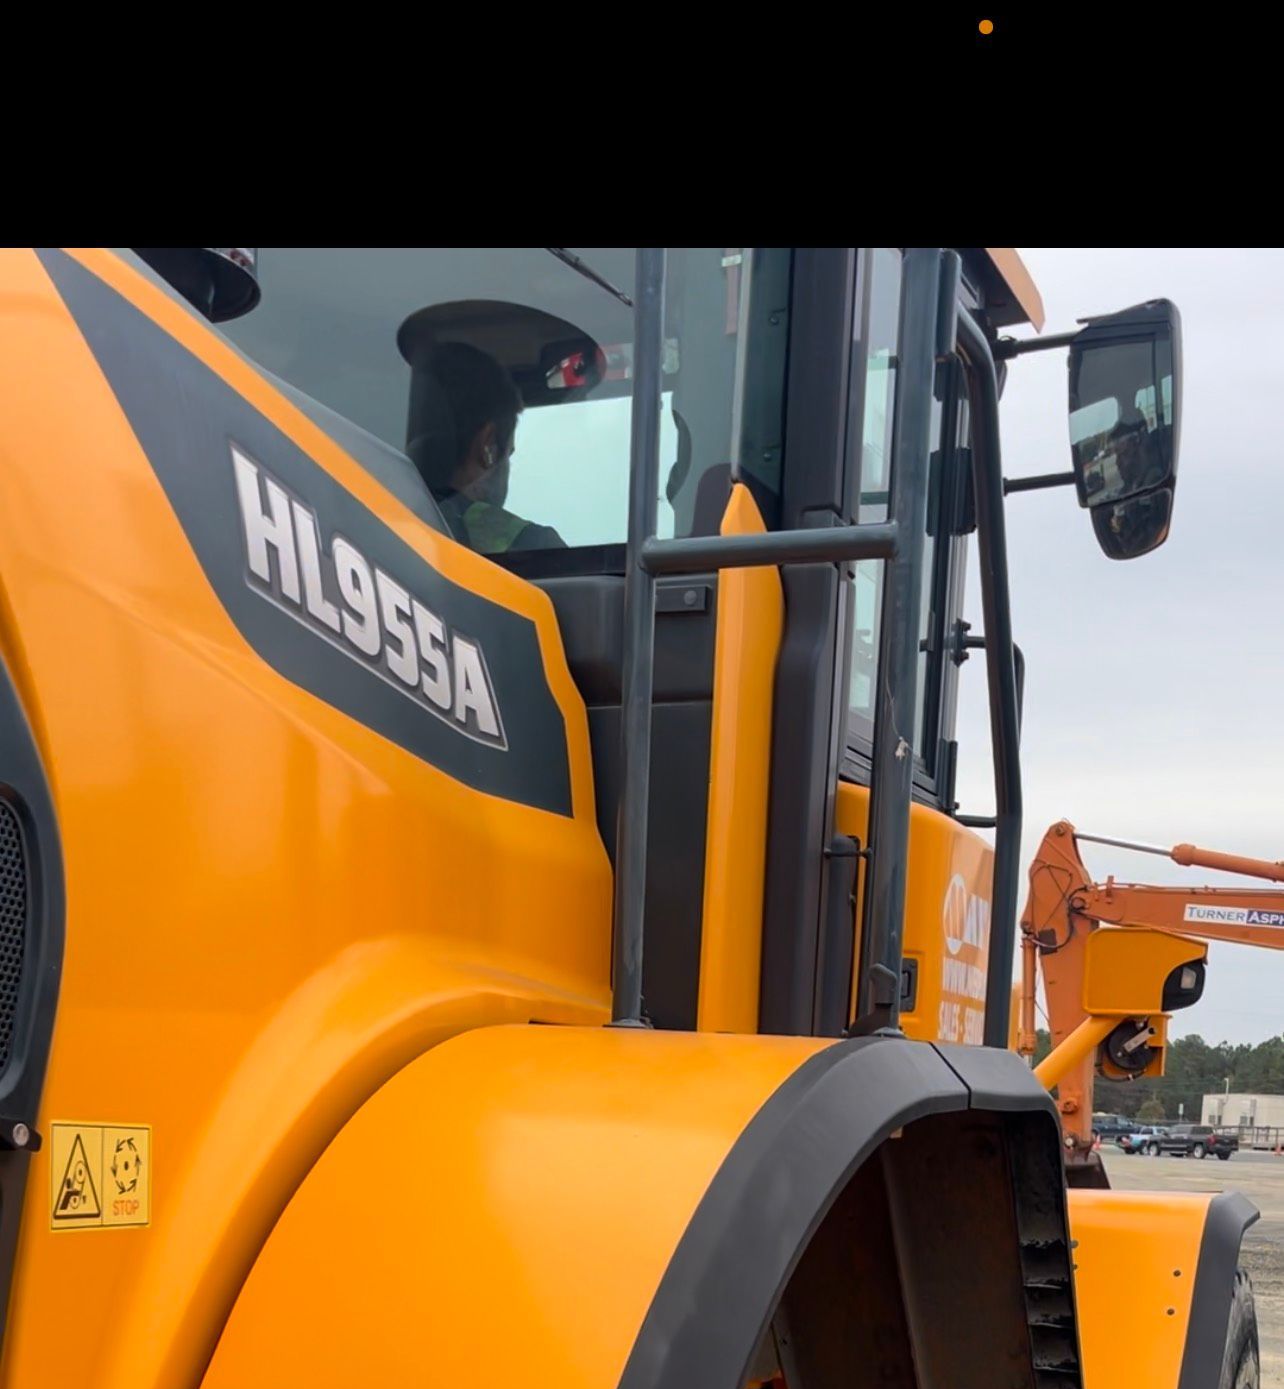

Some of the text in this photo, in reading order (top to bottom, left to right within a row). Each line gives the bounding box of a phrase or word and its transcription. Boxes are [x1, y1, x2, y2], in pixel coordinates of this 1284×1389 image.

[231, 446, 500, 738] HL955A
[1187, 906, 1246, 922] TURNER
[113, 1200, 139, 1216] STOP
